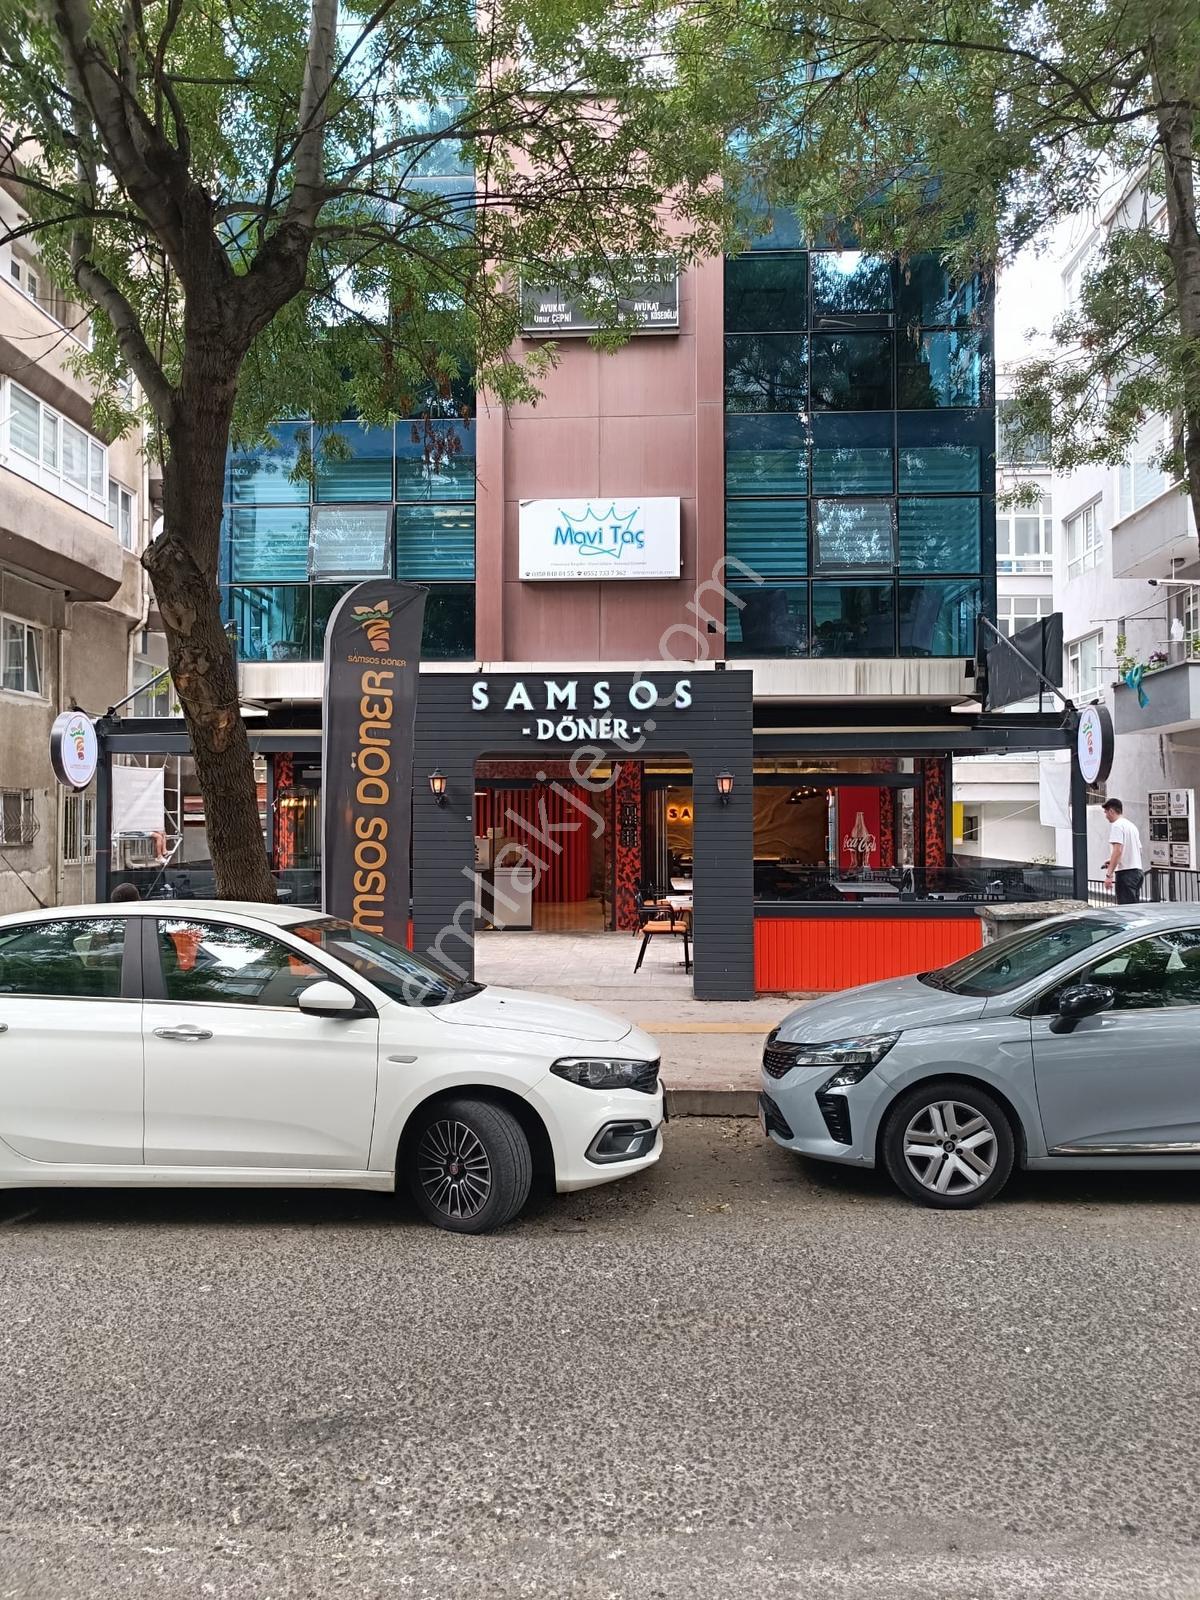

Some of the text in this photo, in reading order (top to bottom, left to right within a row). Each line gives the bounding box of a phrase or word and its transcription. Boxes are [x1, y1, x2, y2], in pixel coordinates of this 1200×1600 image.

[539, 303, 566, 312] AVUKAT
[633, 302, 660, 311] AVUKAT
[553, 526, 645, 549] Mavi Taç
[347, 655, 380, 665] SAMSOS
[471, 680, 693, 711] SAMSOS
